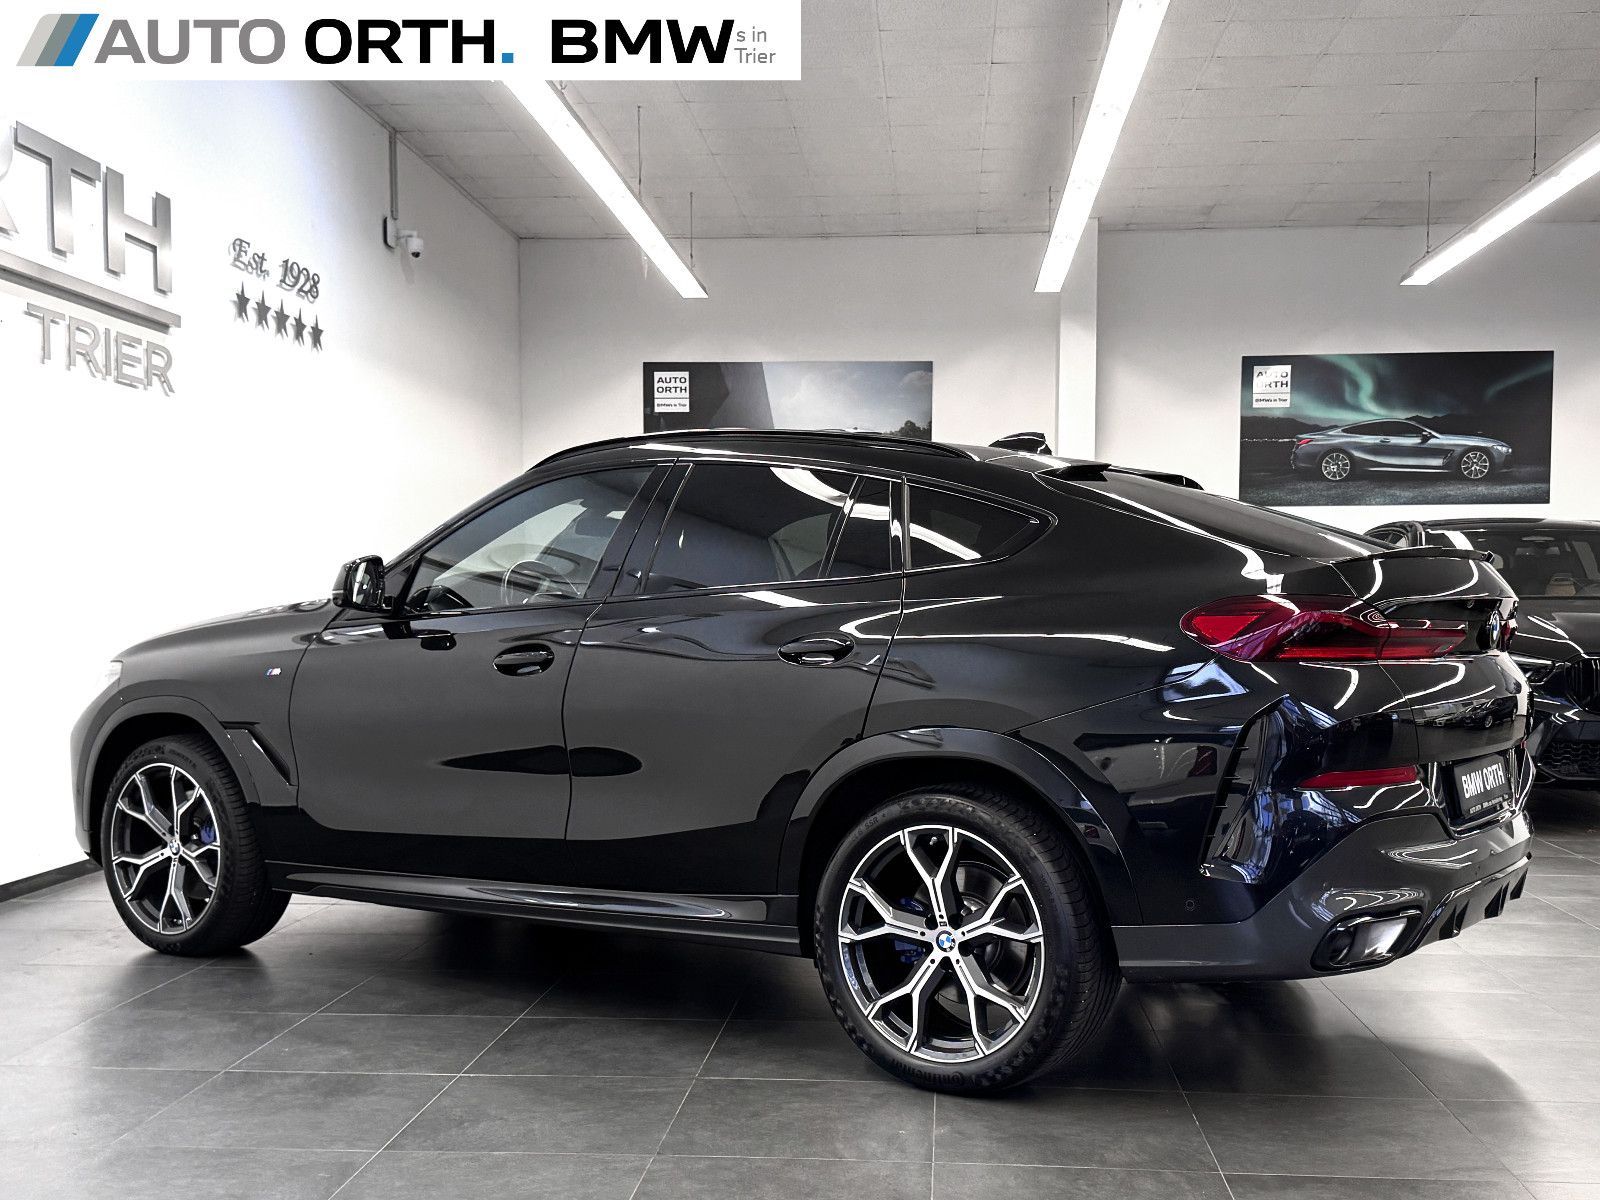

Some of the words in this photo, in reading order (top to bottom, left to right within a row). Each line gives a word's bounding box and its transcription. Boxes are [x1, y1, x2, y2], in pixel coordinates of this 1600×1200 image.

[0, 119, 172, 296] TH
[279, 258, 320, 301] 1928
[25, 302, 175, 395] TRIER
[656, 376, 687, 384] AUTO
[1461, 769, 1484, 799] BMW
[1483, 762, 1505, 791] ORTH
